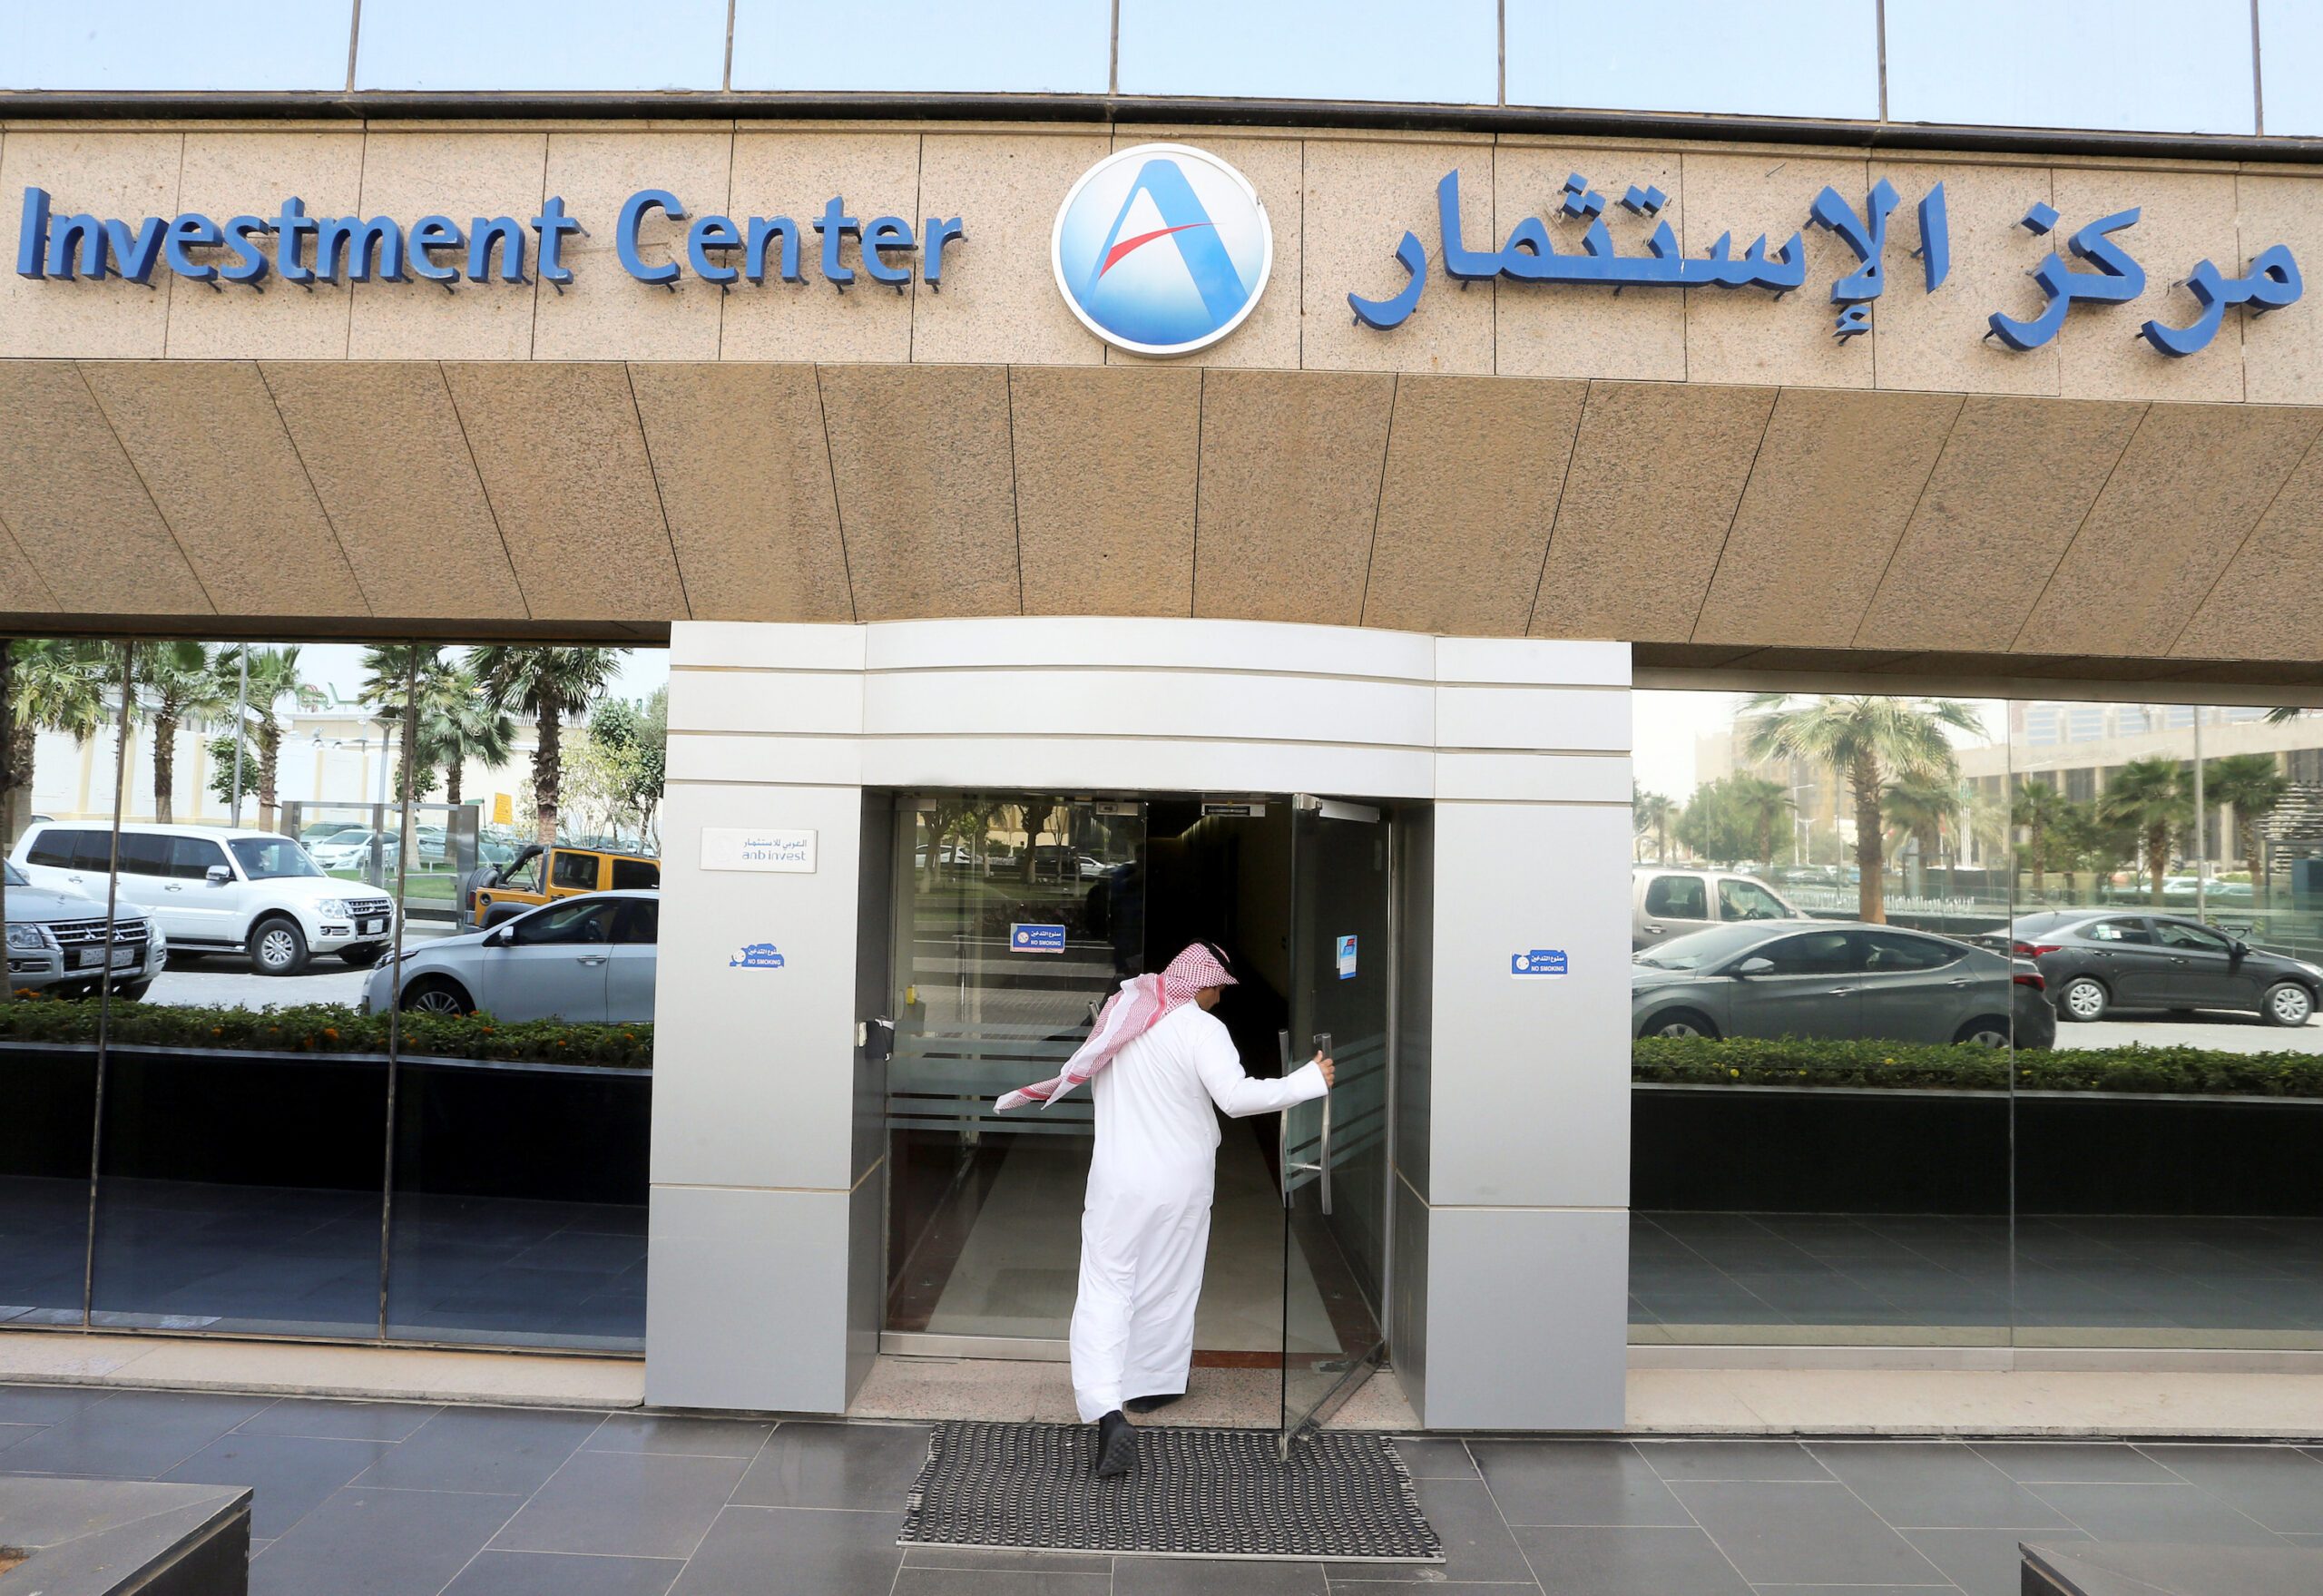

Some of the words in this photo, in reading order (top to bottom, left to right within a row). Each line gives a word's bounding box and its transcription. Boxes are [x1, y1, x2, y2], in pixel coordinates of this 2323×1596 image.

[17, 187, 578, 285] Investment
[616, 189, 964, 284] Center
[1989, 201, 2303, 357] مركز
[742, 850, 766, 860] anb
[768, 850, 806, 861] invest
